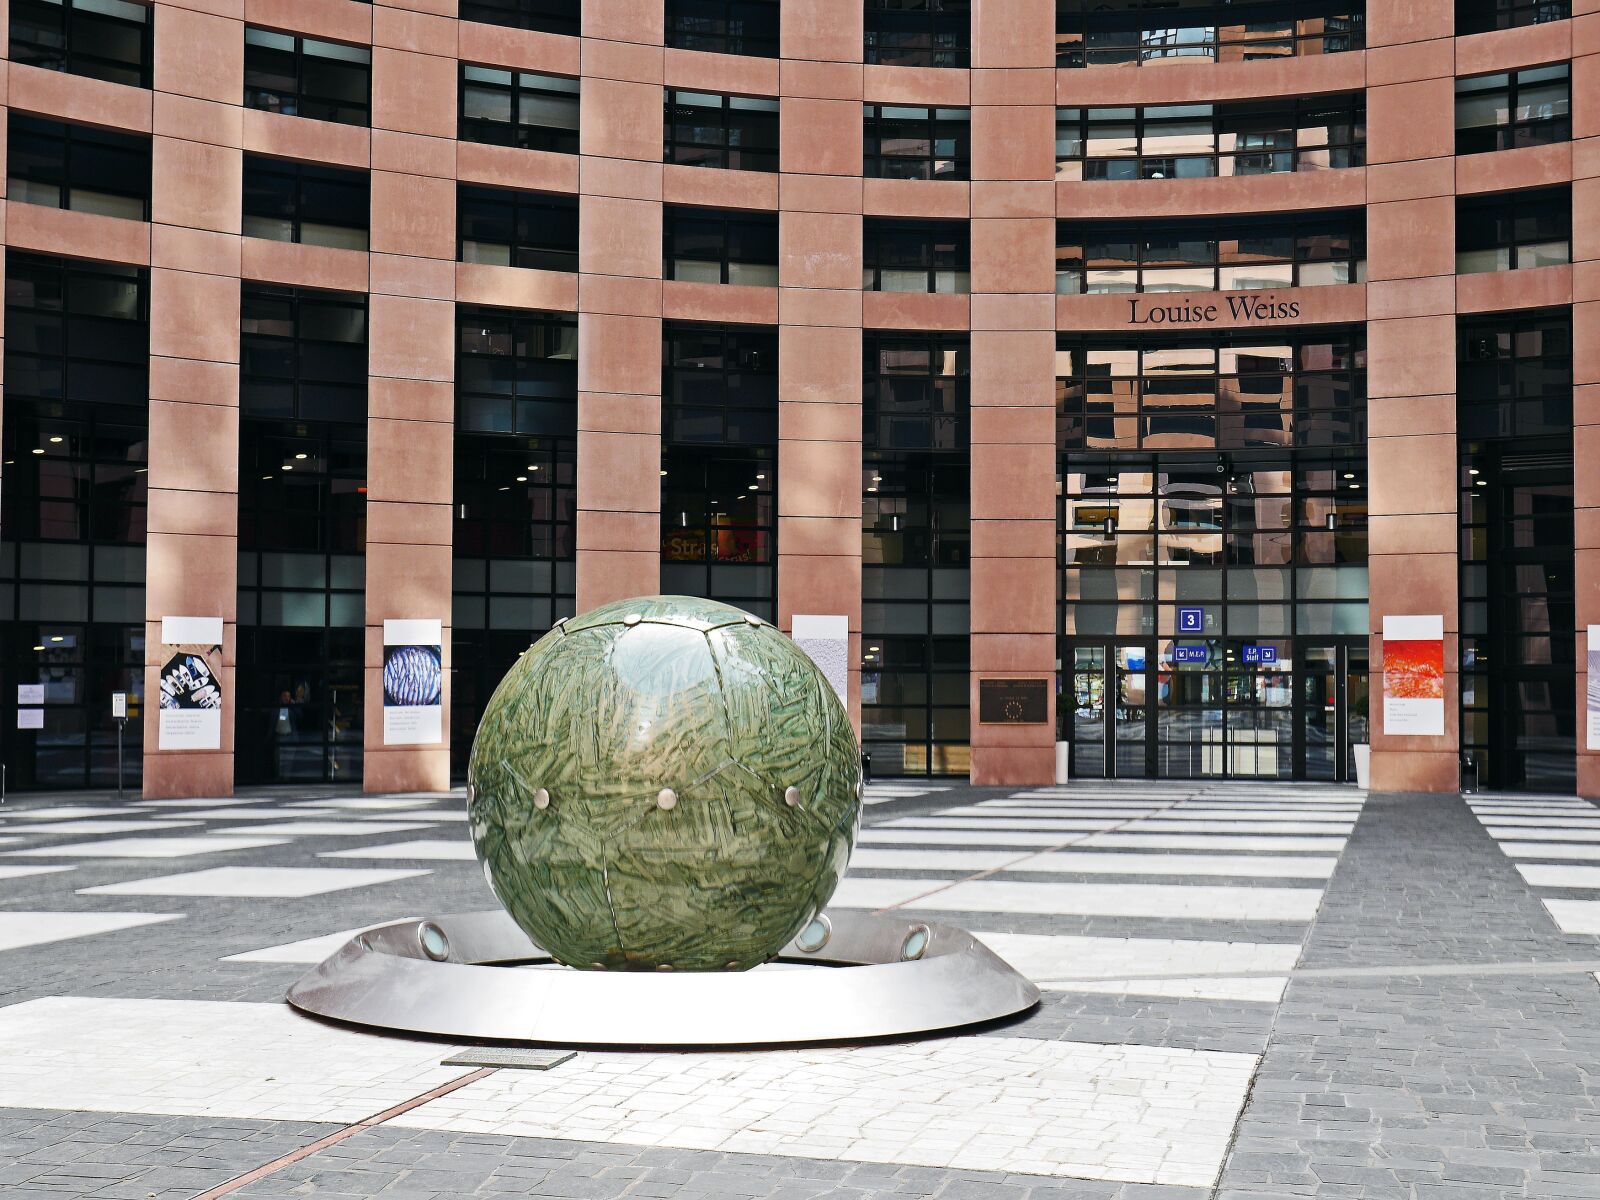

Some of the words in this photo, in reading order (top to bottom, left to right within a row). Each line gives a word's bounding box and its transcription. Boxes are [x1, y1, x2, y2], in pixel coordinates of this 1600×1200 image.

[1127, 298, 1218, 324] Louise
[1225, 295, 1300, 321] Weiss
[1187, 614, 1195, 626] 3
